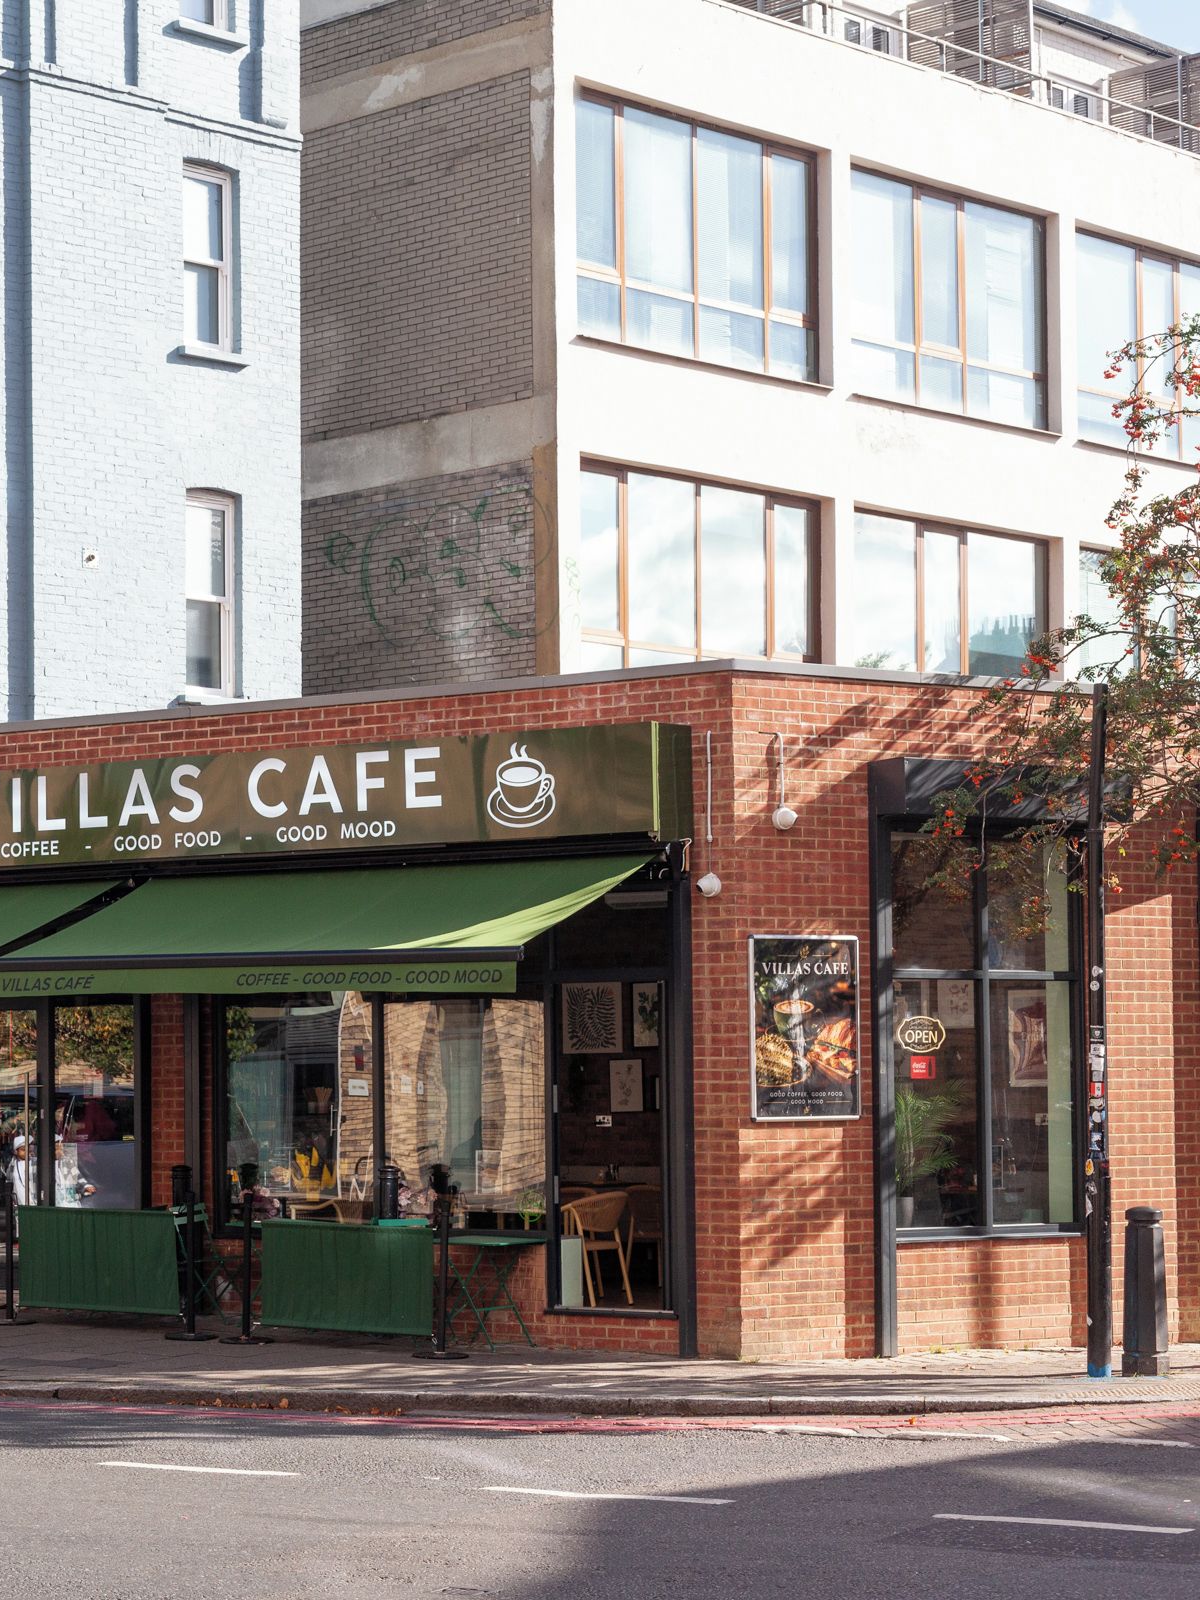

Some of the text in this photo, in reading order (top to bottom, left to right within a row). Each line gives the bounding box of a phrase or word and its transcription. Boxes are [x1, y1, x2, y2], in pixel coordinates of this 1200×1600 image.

[246, 746, 443, 819] CAFE
[1, 839, 60, 859] COFFEE
[113, 833, 162, 853] GOOD
[174, 831, 222, 849] FOOD
[276, 824, 328, 843] GOOD
[340, 820, 396, 840] MOOD
[236, 972, 291, 986] COFFEE
[302, 971, 347, 985] GOOD
[349, 970, 393, 985] FOOD
[405, 969, 451, 984] GOOD
[453, 968, 504, 984] MOOD
[762, 962, 849, 975] VILLAS CAFE
[2, 974, 96, 992] VILLAS CAFÉ
[905, 1030, 938, 1043] OPEN
